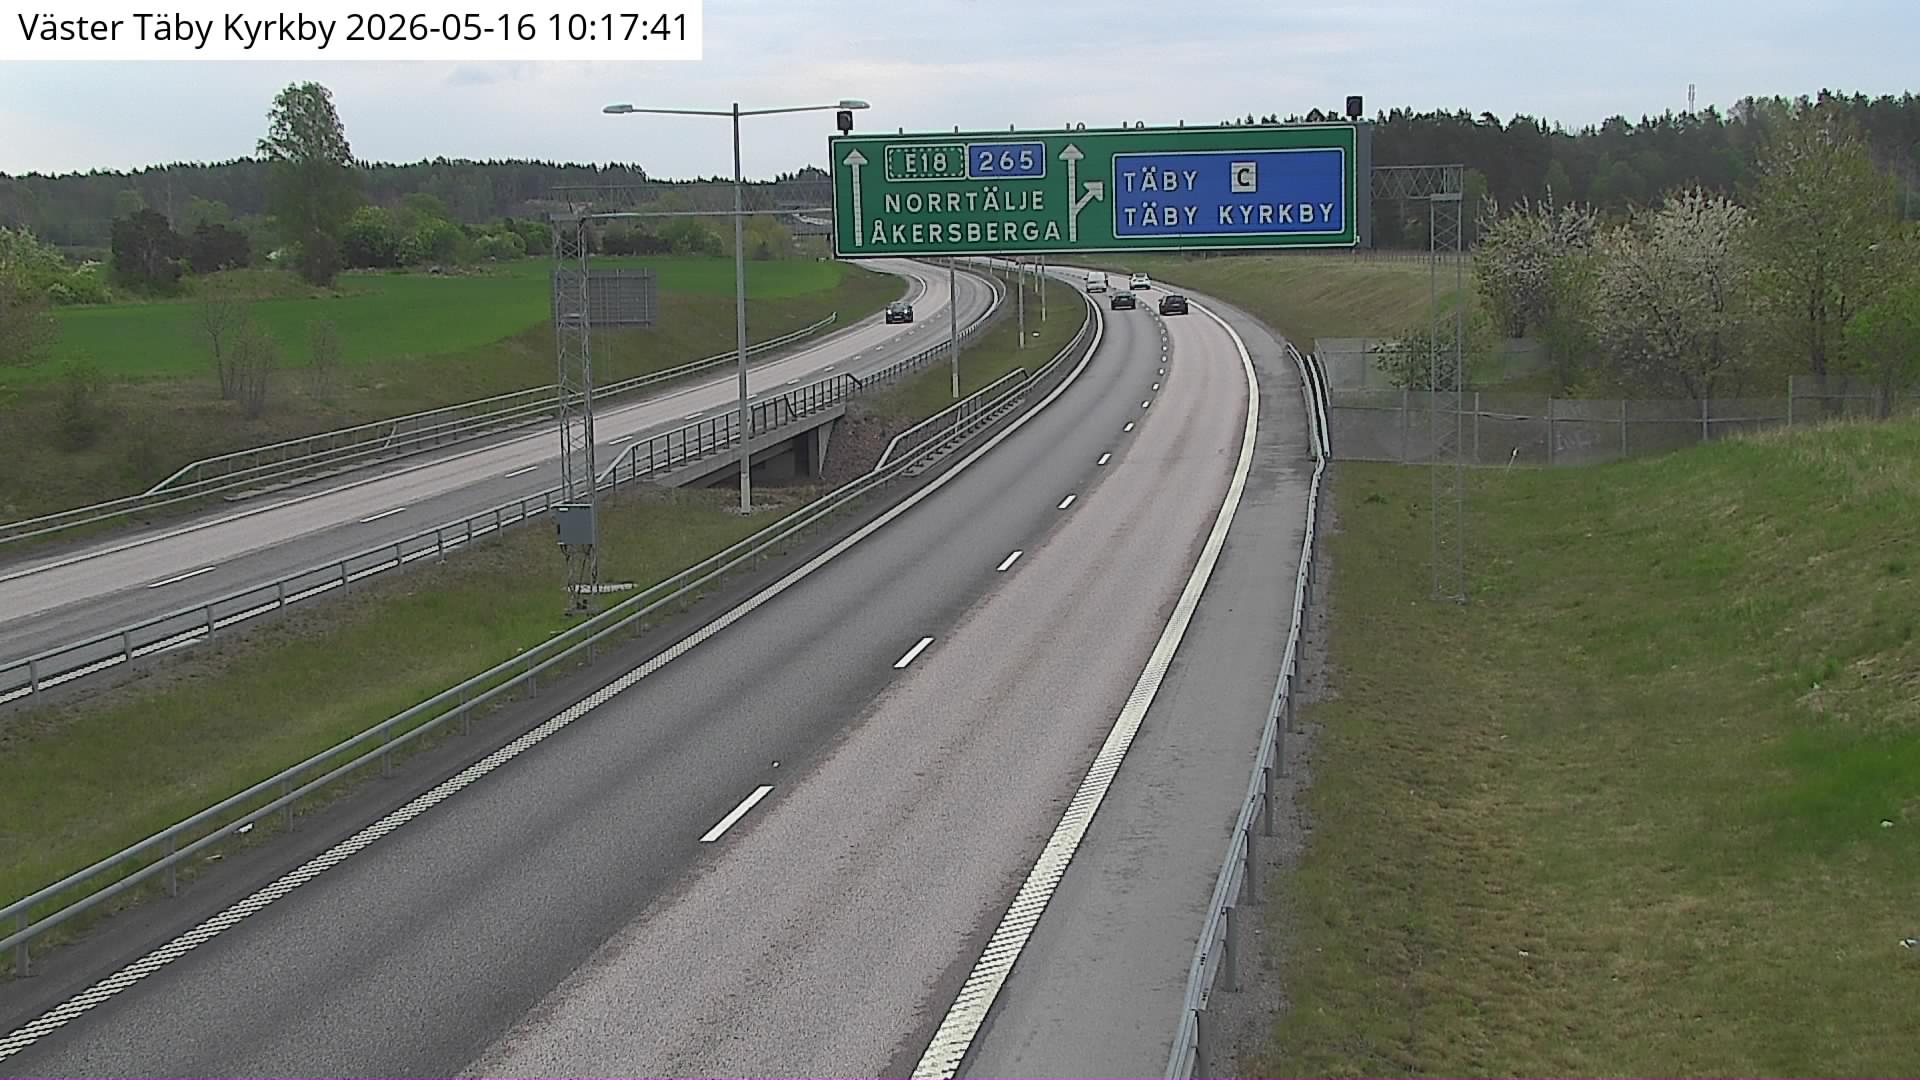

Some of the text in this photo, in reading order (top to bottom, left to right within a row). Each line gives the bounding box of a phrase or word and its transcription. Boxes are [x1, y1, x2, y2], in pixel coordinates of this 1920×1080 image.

[904, 152, 948, 173] E18
[979, 151, 1033, 171] 265
[1124, 167, 1251, 193] TÄBY C
[885, 187, 1044, 213] NORRTÄLJE
[1125, 202, 1334, 227] TÄBY KYRKBY
[872, 219, 1061, 244] ÅKERSBERGA
